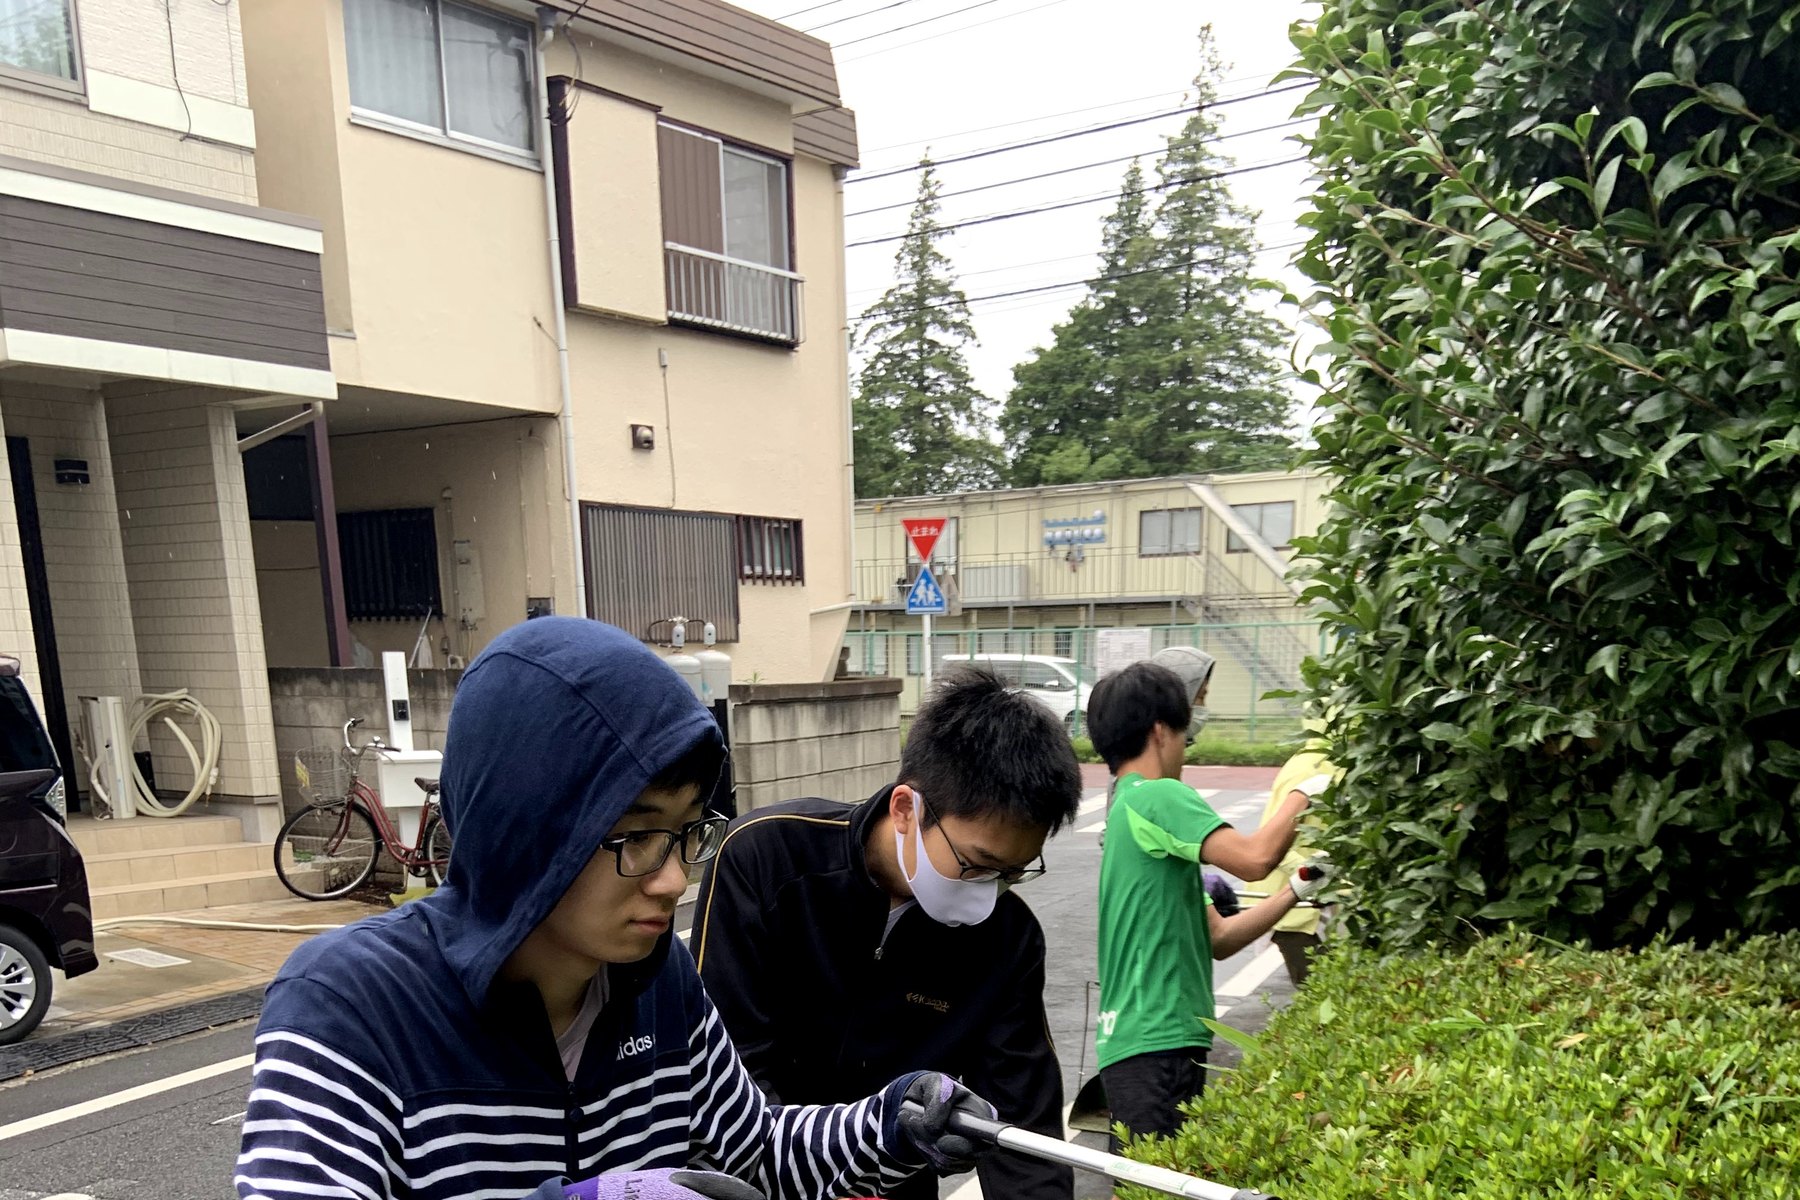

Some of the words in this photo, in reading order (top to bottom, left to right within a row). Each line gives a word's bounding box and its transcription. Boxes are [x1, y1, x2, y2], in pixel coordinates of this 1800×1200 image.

[911, 525, 939, 537] 止まれ
[616, 1035, 653, 1061] idas
